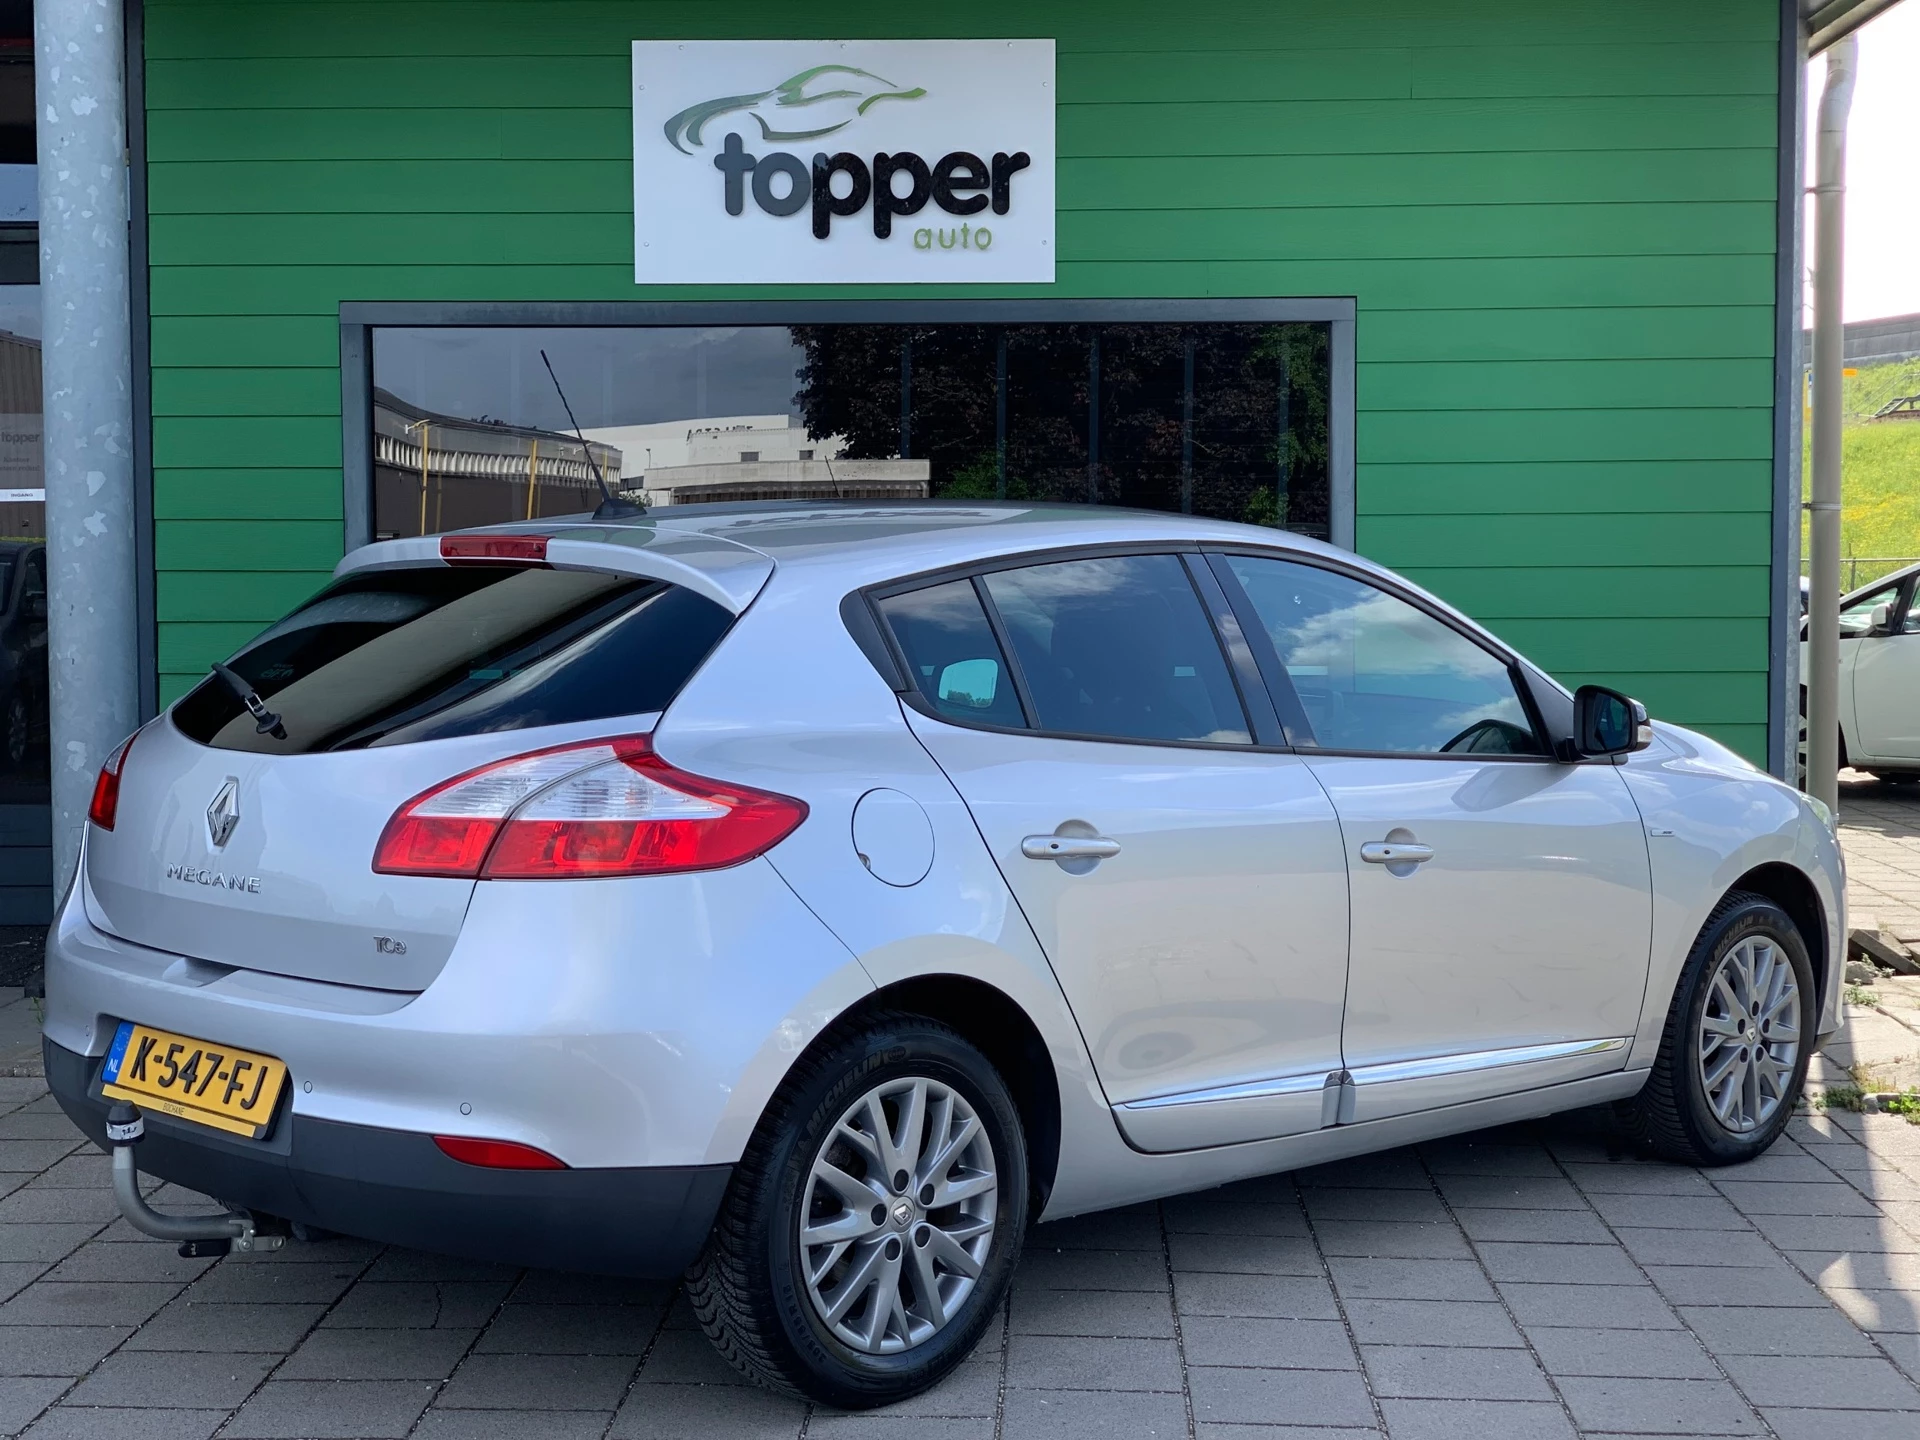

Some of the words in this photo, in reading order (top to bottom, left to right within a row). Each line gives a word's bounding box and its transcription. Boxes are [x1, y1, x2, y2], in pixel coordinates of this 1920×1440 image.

[713, 132, 1031, 240] topper
[913, 222, 993, 251] auto
[166, 863, 262, 894] MEGANE
[373, 936, 407, 955] TCe
[107, 1058, 118, 1073] NL
[130, 1035, 269, 1110] K-547-FJ
[806, 1049, 883, 1138] MICHELIN
